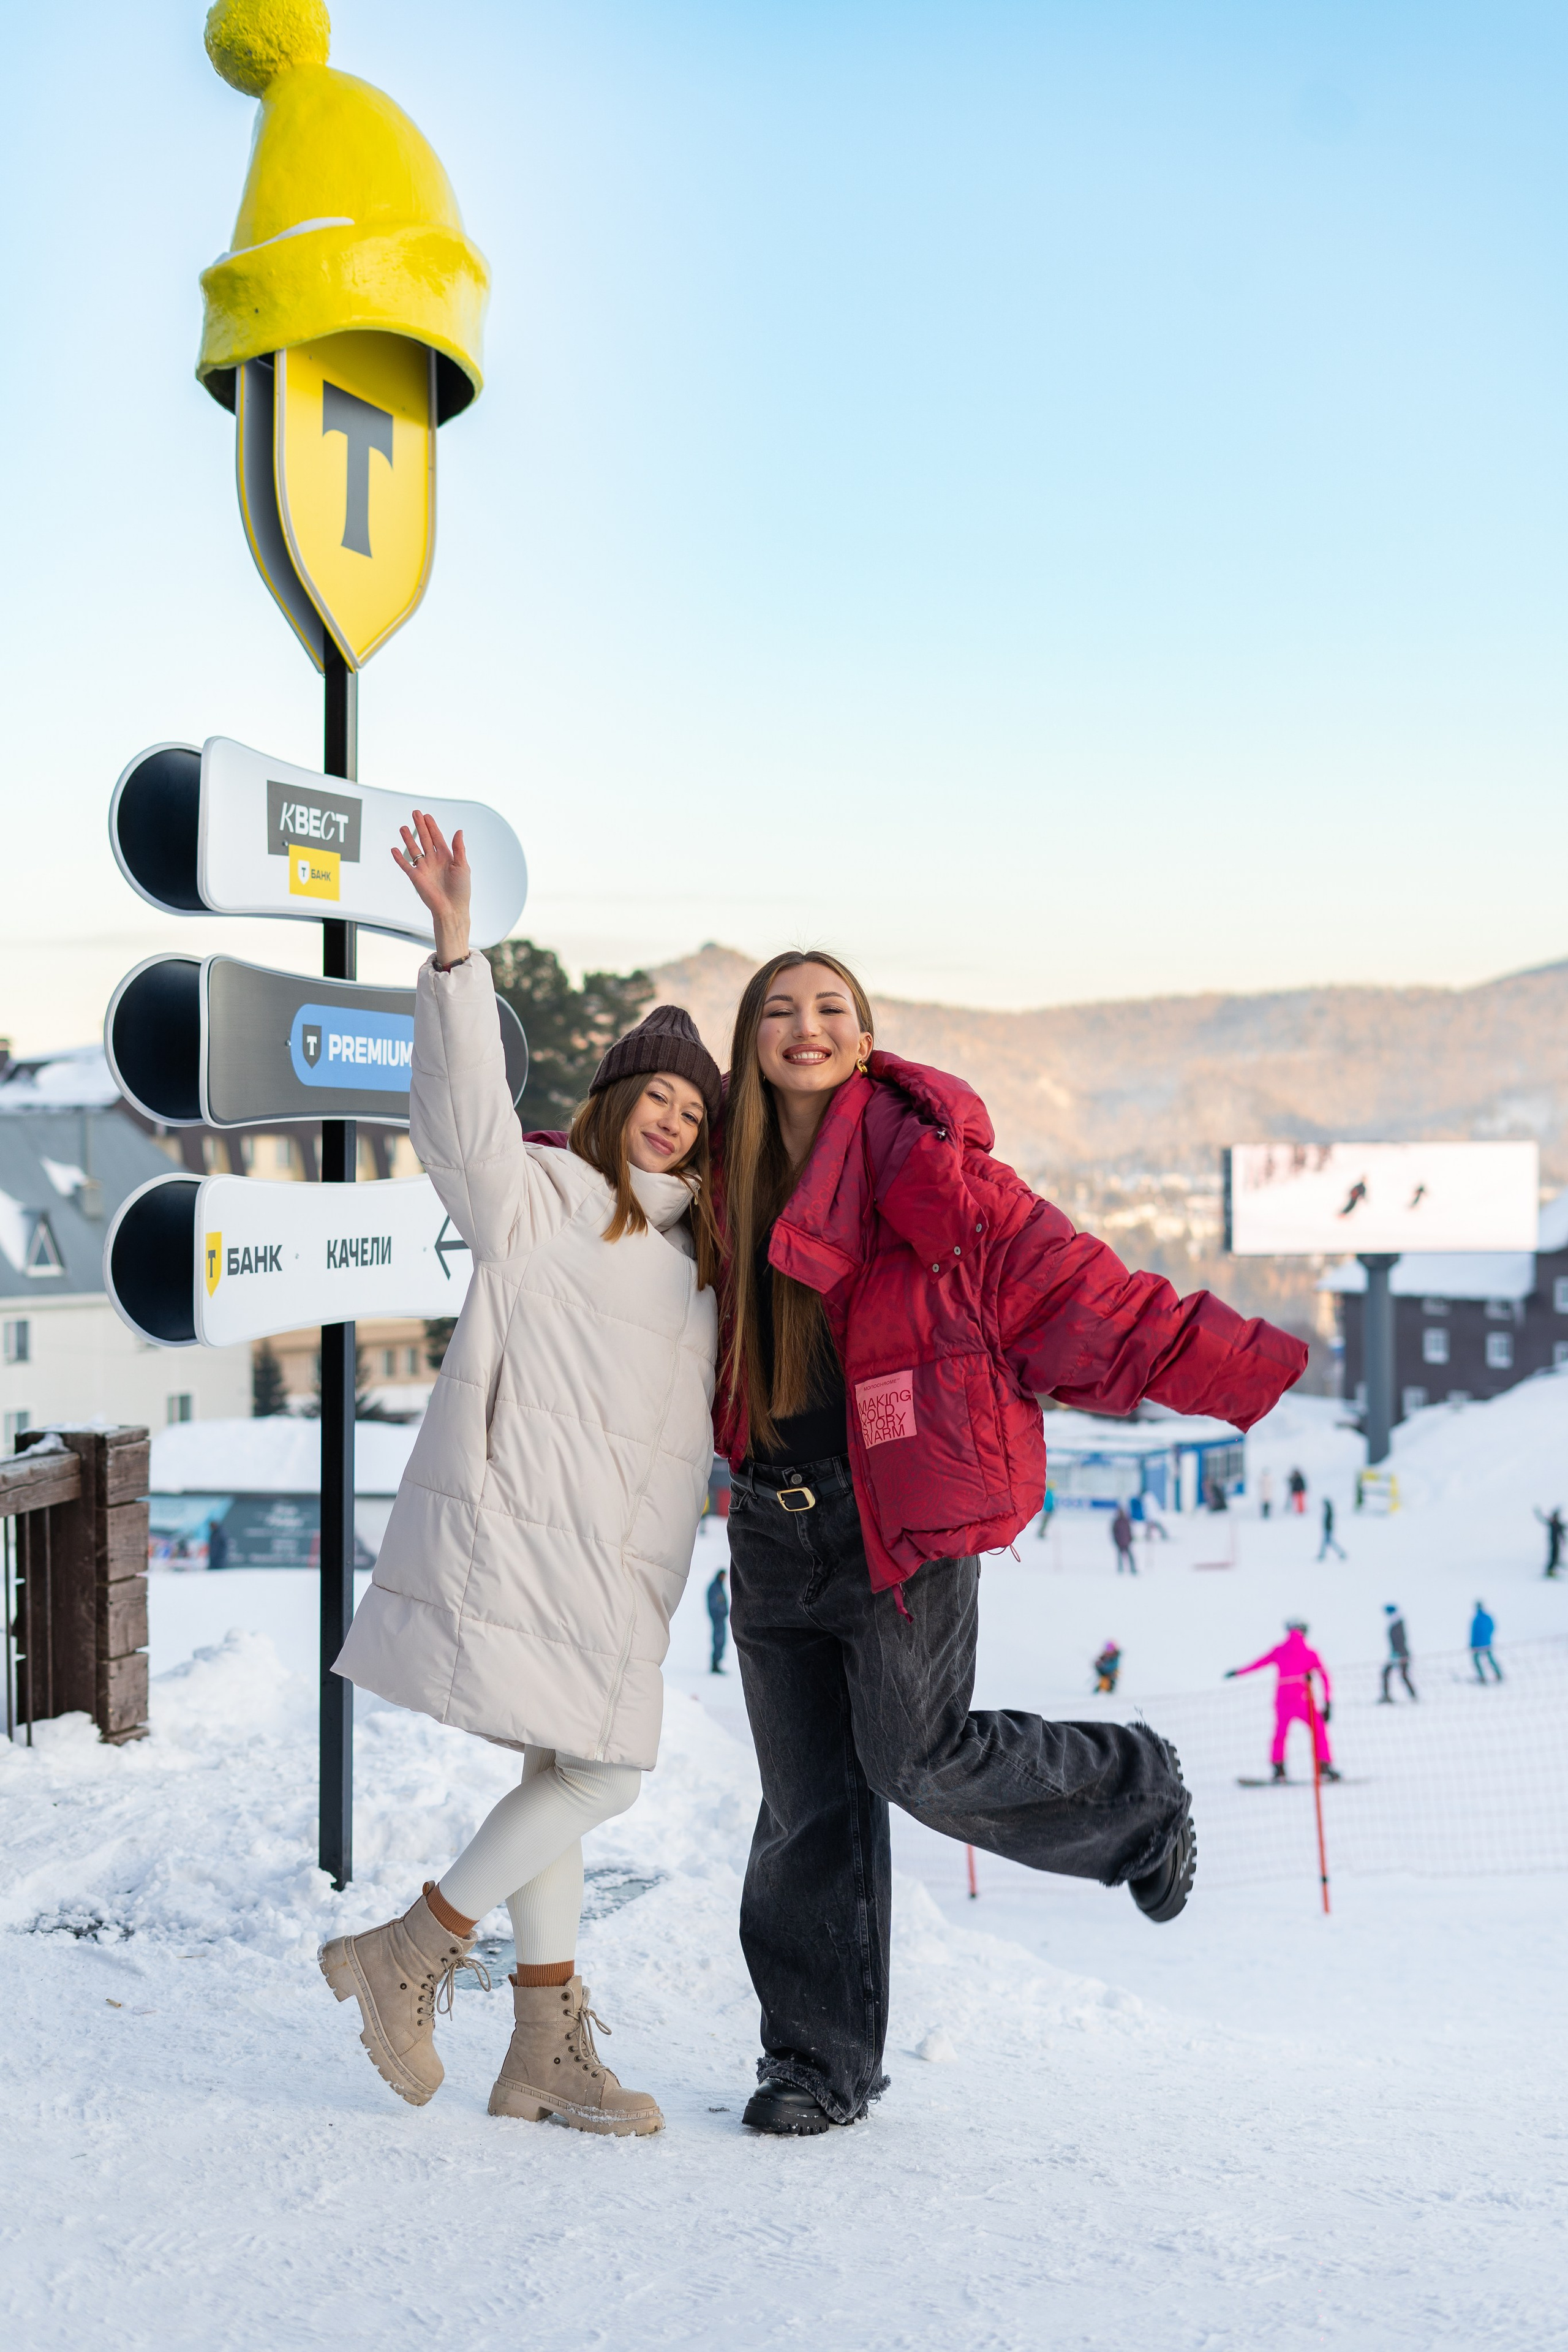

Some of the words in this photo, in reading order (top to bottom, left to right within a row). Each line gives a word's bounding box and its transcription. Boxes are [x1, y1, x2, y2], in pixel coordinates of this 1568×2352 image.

[279, 802, 349, 843] КВЕСТ
[311, 869, 331, 882] БАНК
[328, 1034, 414, 1067] PREMIUM
[227, 1245, 282, 1276] БАНК
[327, 1236, 391, 1269] КАЧЕЛИ
[859, 1390, 911, 1414] MAKING
[861, 1404, 895, 1423] COLD
[862, 1412, 906, 1435] STORY
[864, 1424, 905, 1446] WARM
